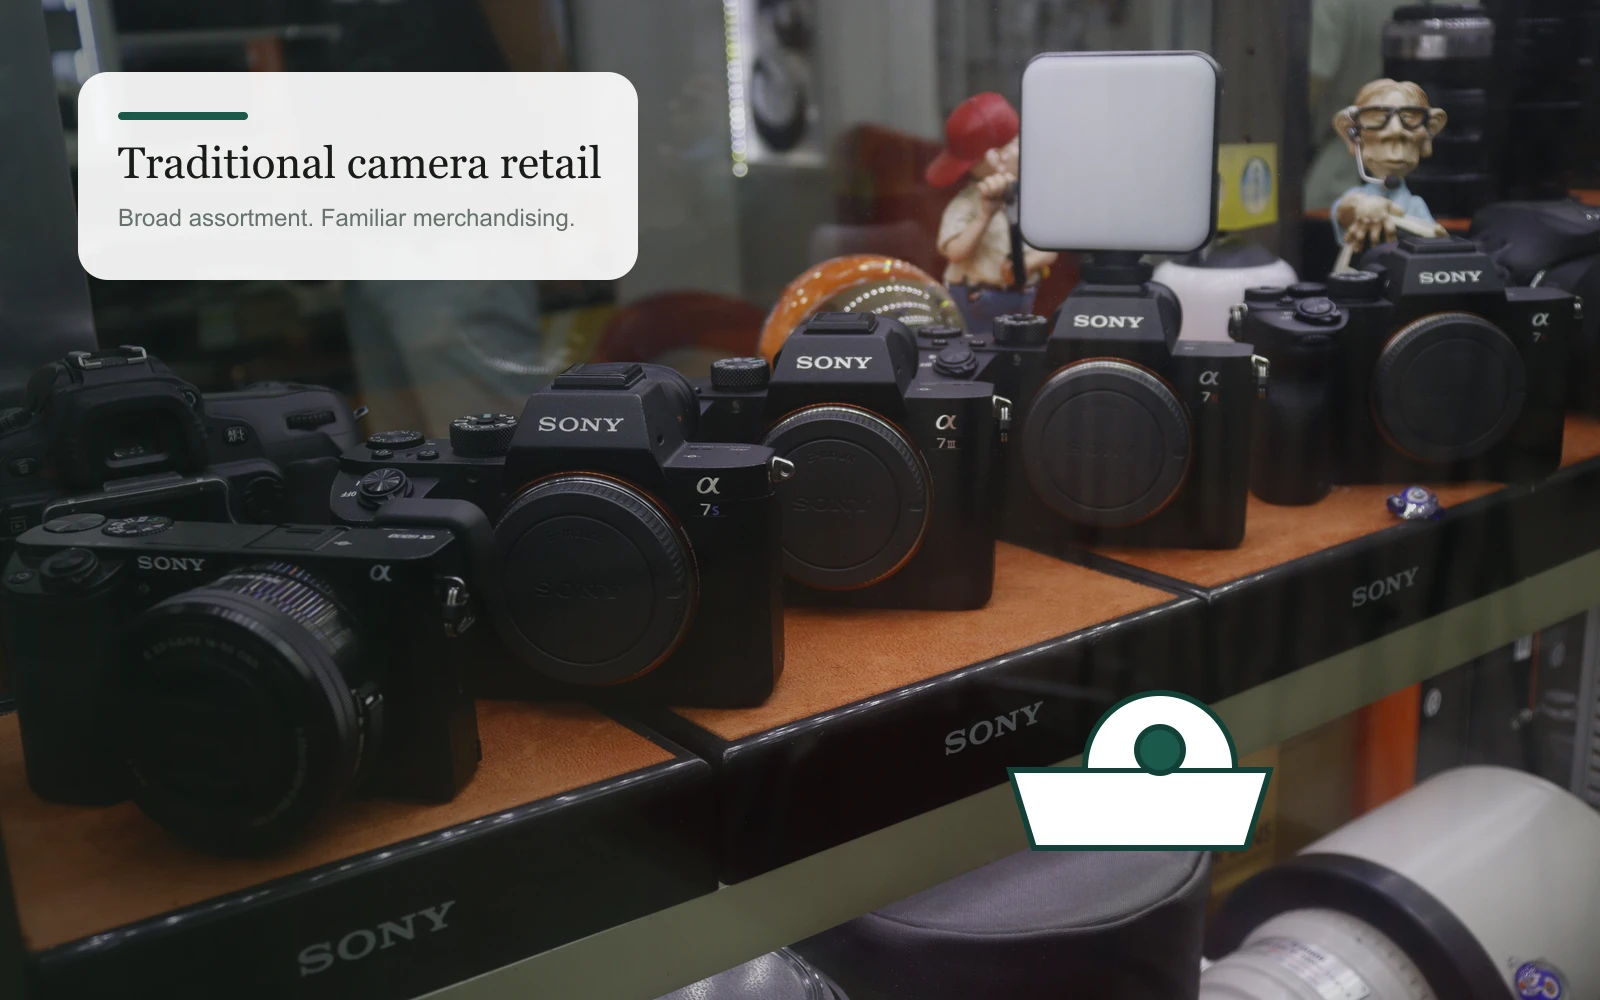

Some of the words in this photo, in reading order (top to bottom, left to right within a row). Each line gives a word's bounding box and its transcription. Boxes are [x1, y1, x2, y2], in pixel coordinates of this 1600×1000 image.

[1418, 270, 1483, 285] SONY
[1073, 314, 1144, 329] SONY
[796, 355, 873, 370] SONY
[537, 416, 625, 433] SONY
[137, 556, 206, 573] SONY
[1352, 566, 1420, 608] SONY
[944, 700, 1044, 756] SONY
[297, 900, 456, 977] SONY
